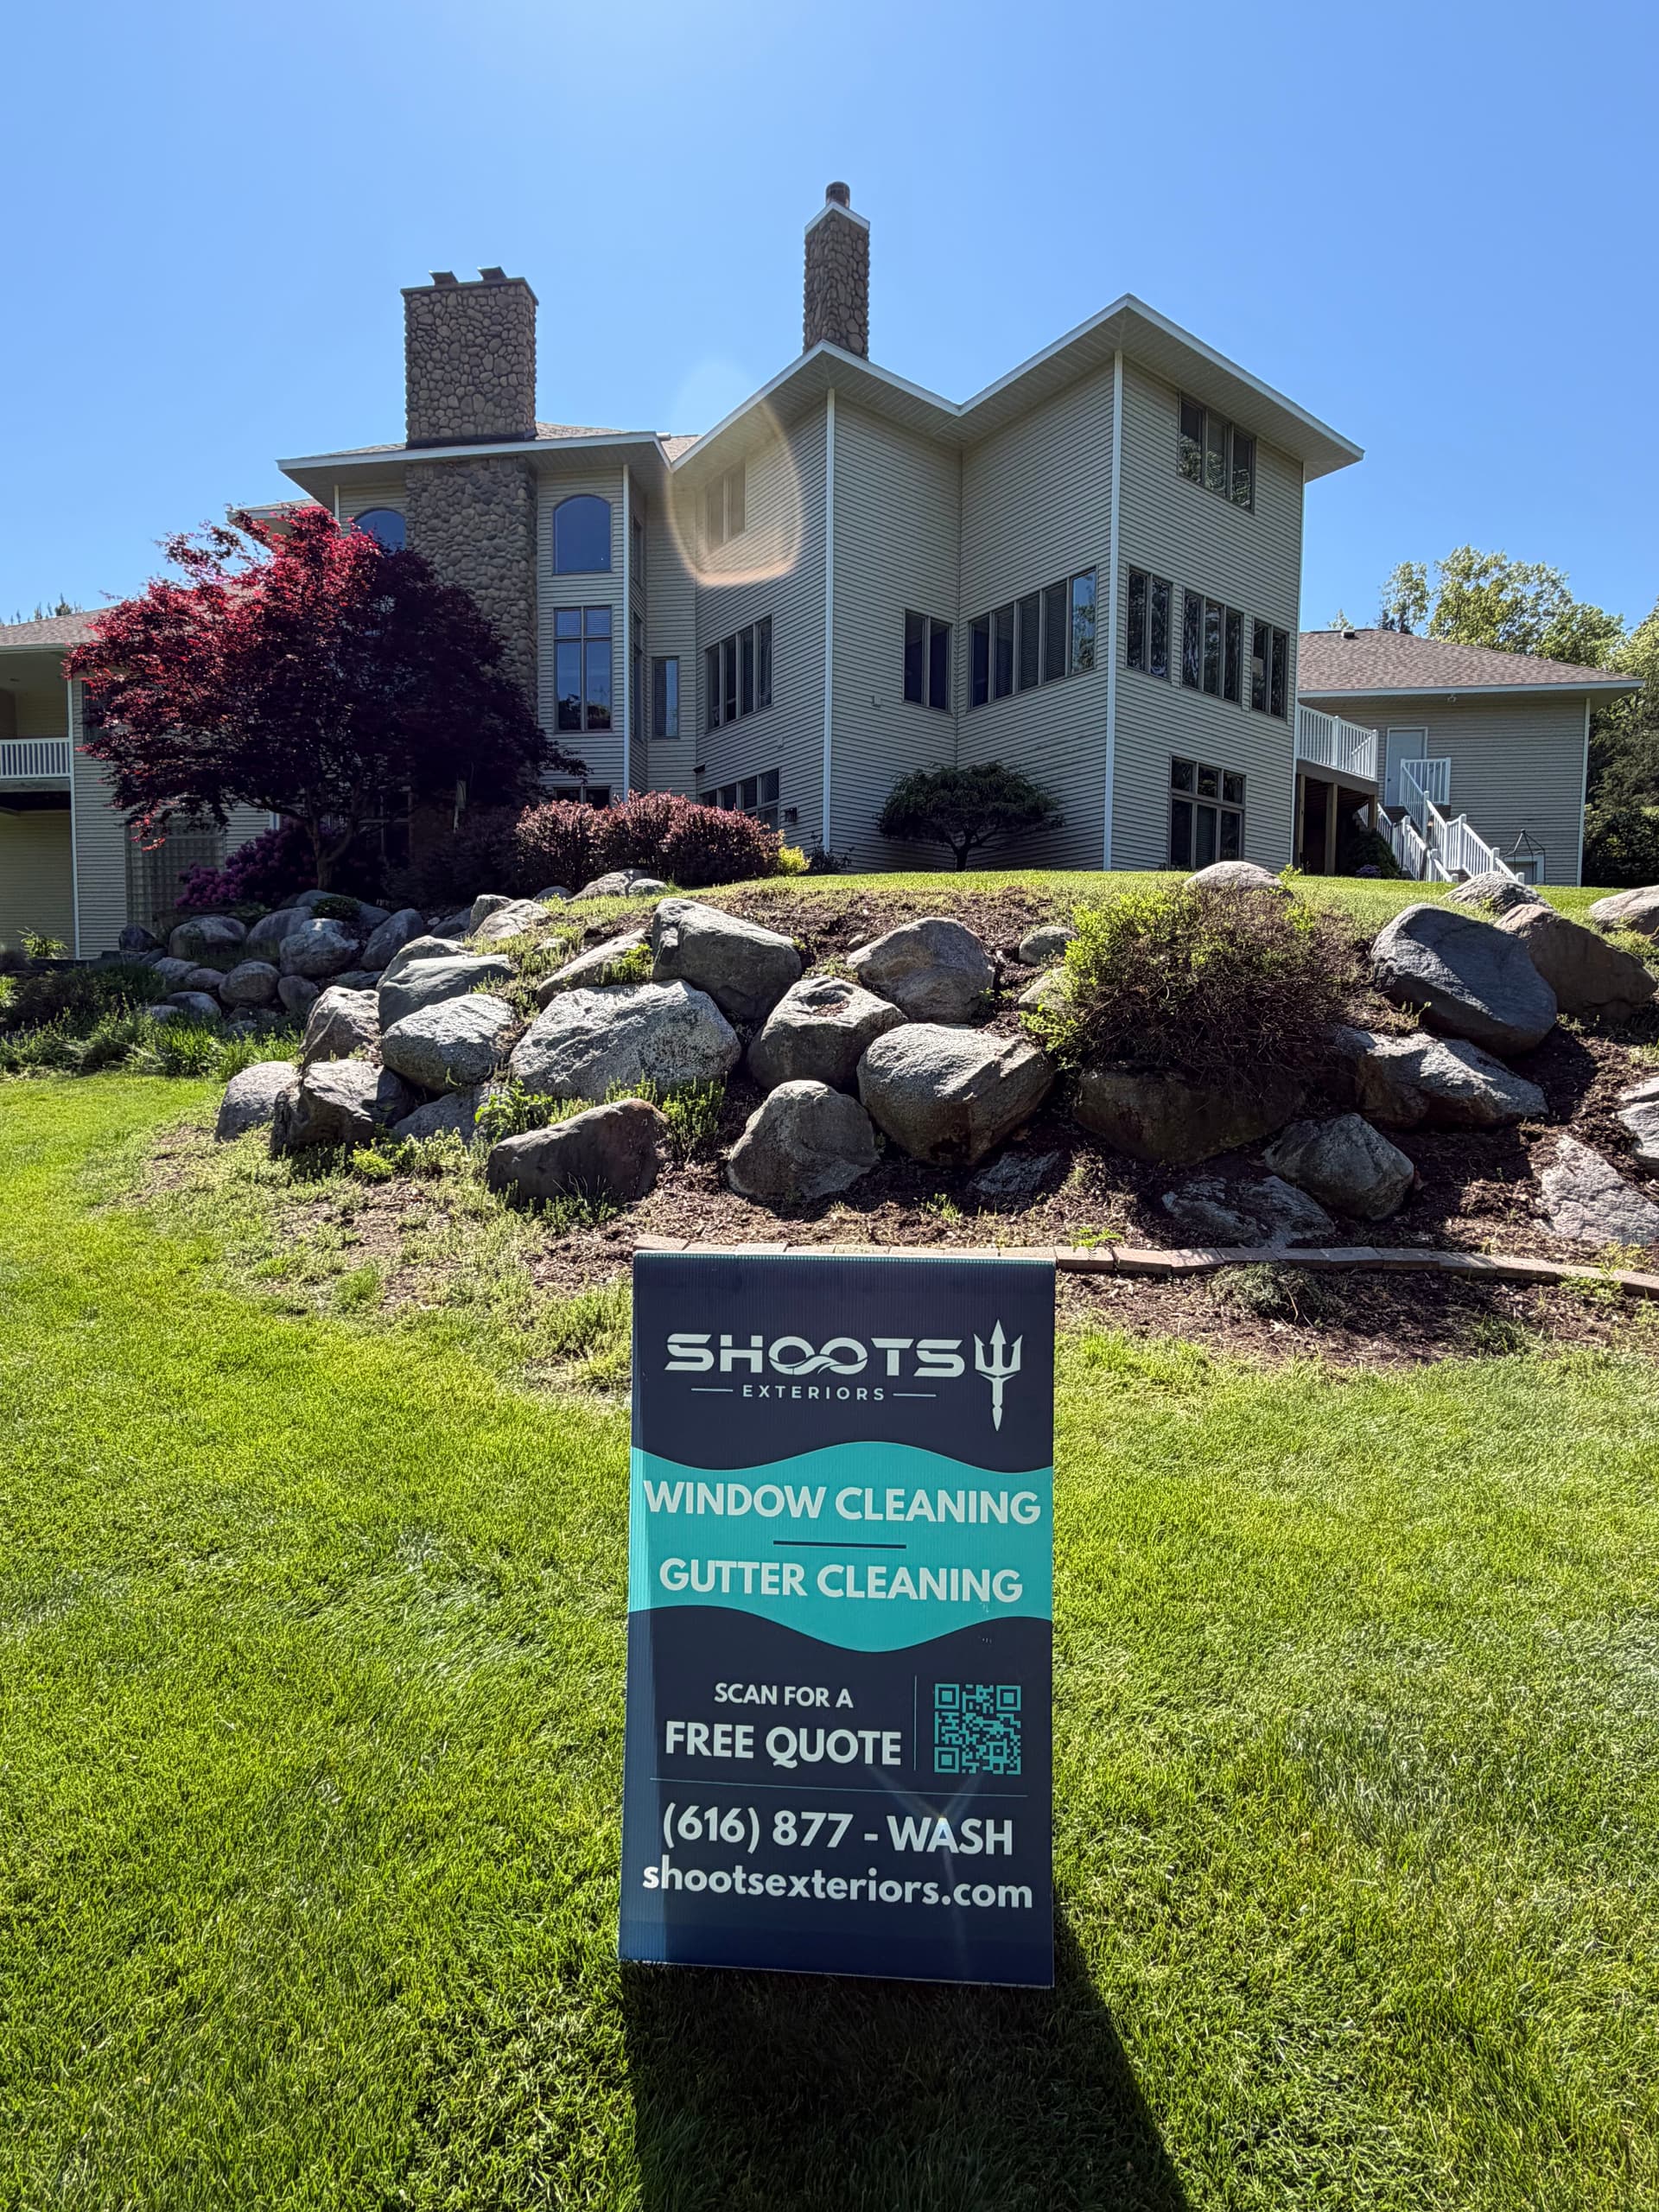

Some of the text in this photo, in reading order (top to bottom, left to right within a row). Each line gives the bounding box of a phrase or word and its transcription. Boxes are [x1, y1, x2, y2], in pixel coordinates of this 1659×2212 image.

[664, 1333, 965, 1377] SHOOTS
[743, 1384, 885, 1401] EXTERIORS
[643, 1480, 1040, 1524] WINDOW CLEANING
[659, 1558, 1022, 1603] GUTTER CLEANING
[715, 1682, 854, 1708] SCAN FOR A
[665, 1720, 901, 1769] FREE QUOTE
[663, 1802, 760, 1853] (616)
[772, 1810, 854, 1847] 877
[887, 1815, 1013, 1855] WASH
[642, 1854, 1033, 1908] shootsexteriors.com
